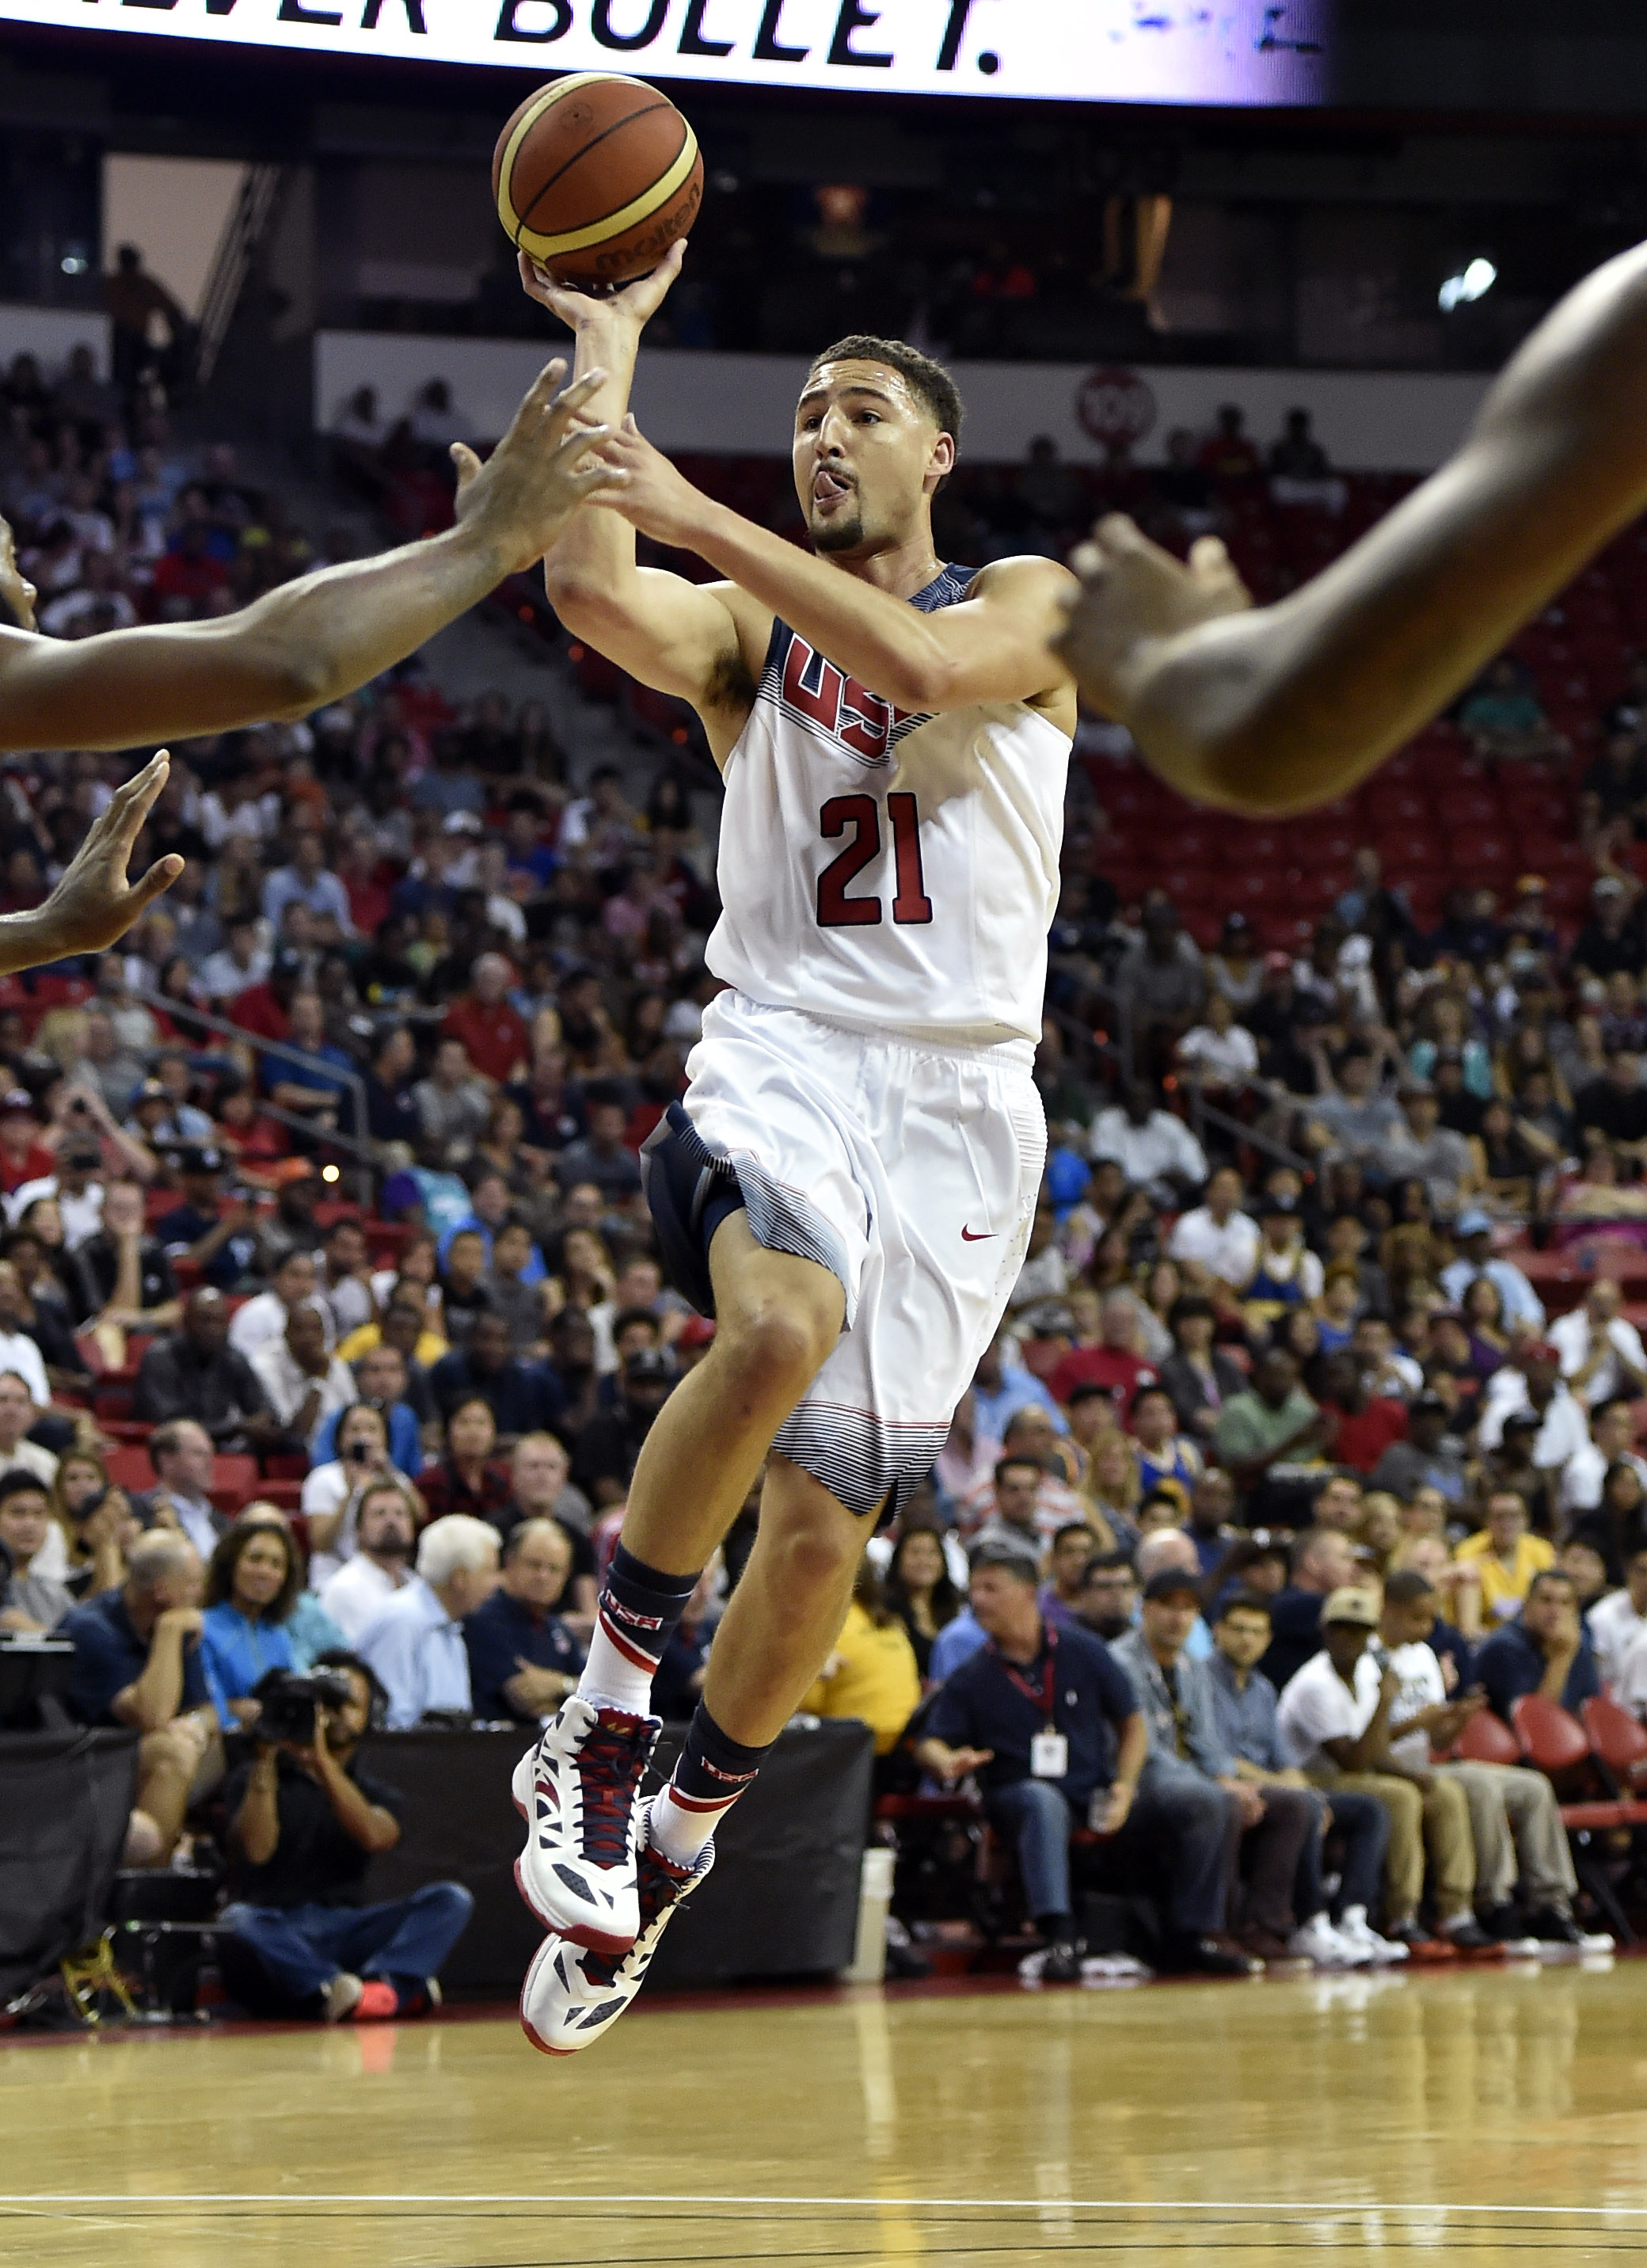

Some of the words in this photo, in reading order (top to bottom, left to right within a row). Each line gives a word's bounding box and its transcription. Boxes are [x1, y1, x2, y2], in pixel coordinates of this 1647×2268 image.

[595, 183, 700, 270] molten
[781, 632, 916, 760] US
[816, 792, 933, 927] 21
[605, 1589, 664, 1631] USA
[701, 1756, 759, 1783] USA
